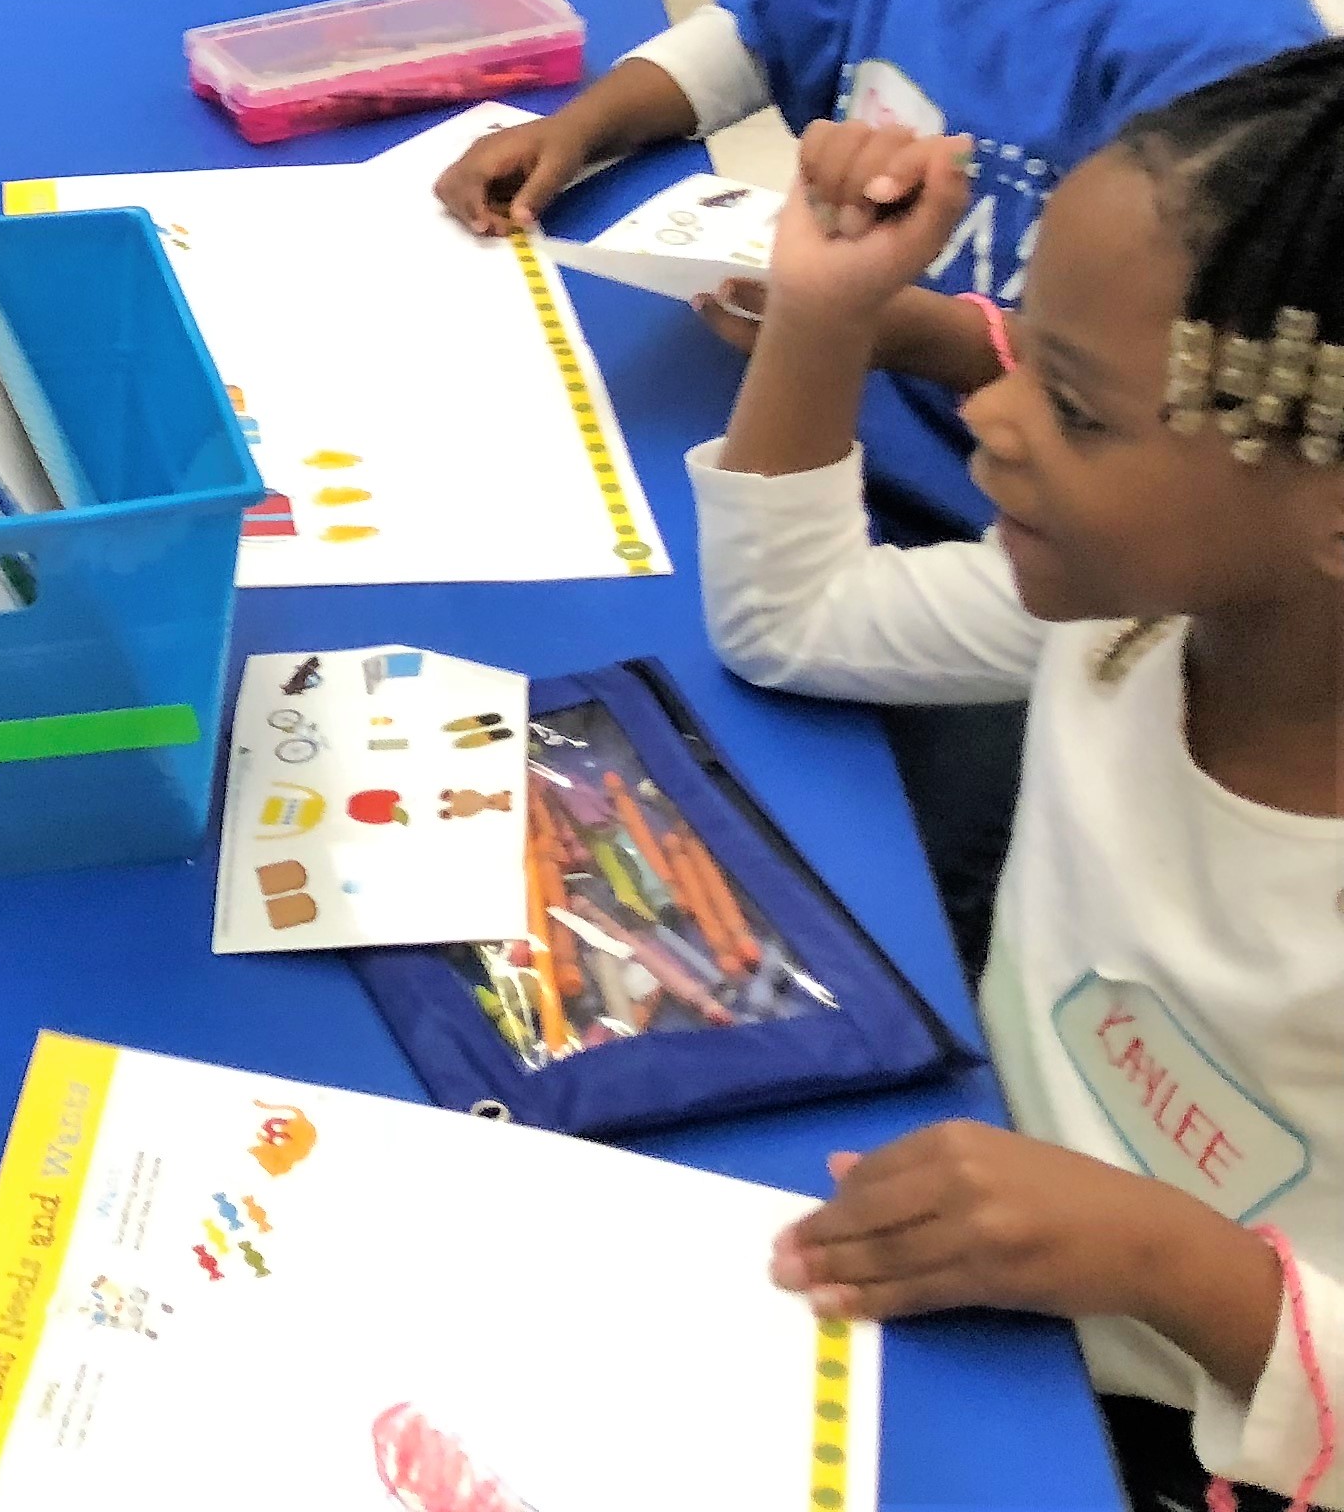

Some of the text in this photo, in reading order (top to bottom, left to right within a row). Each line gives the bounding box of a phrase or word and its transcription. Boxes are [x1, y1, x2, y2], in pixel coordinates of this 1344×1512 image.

[41, 1080, 92, 1178] Wants
[1096, 1001, 1245, 1187] KAYLEE
[28, 1191, 61, 1249] and
